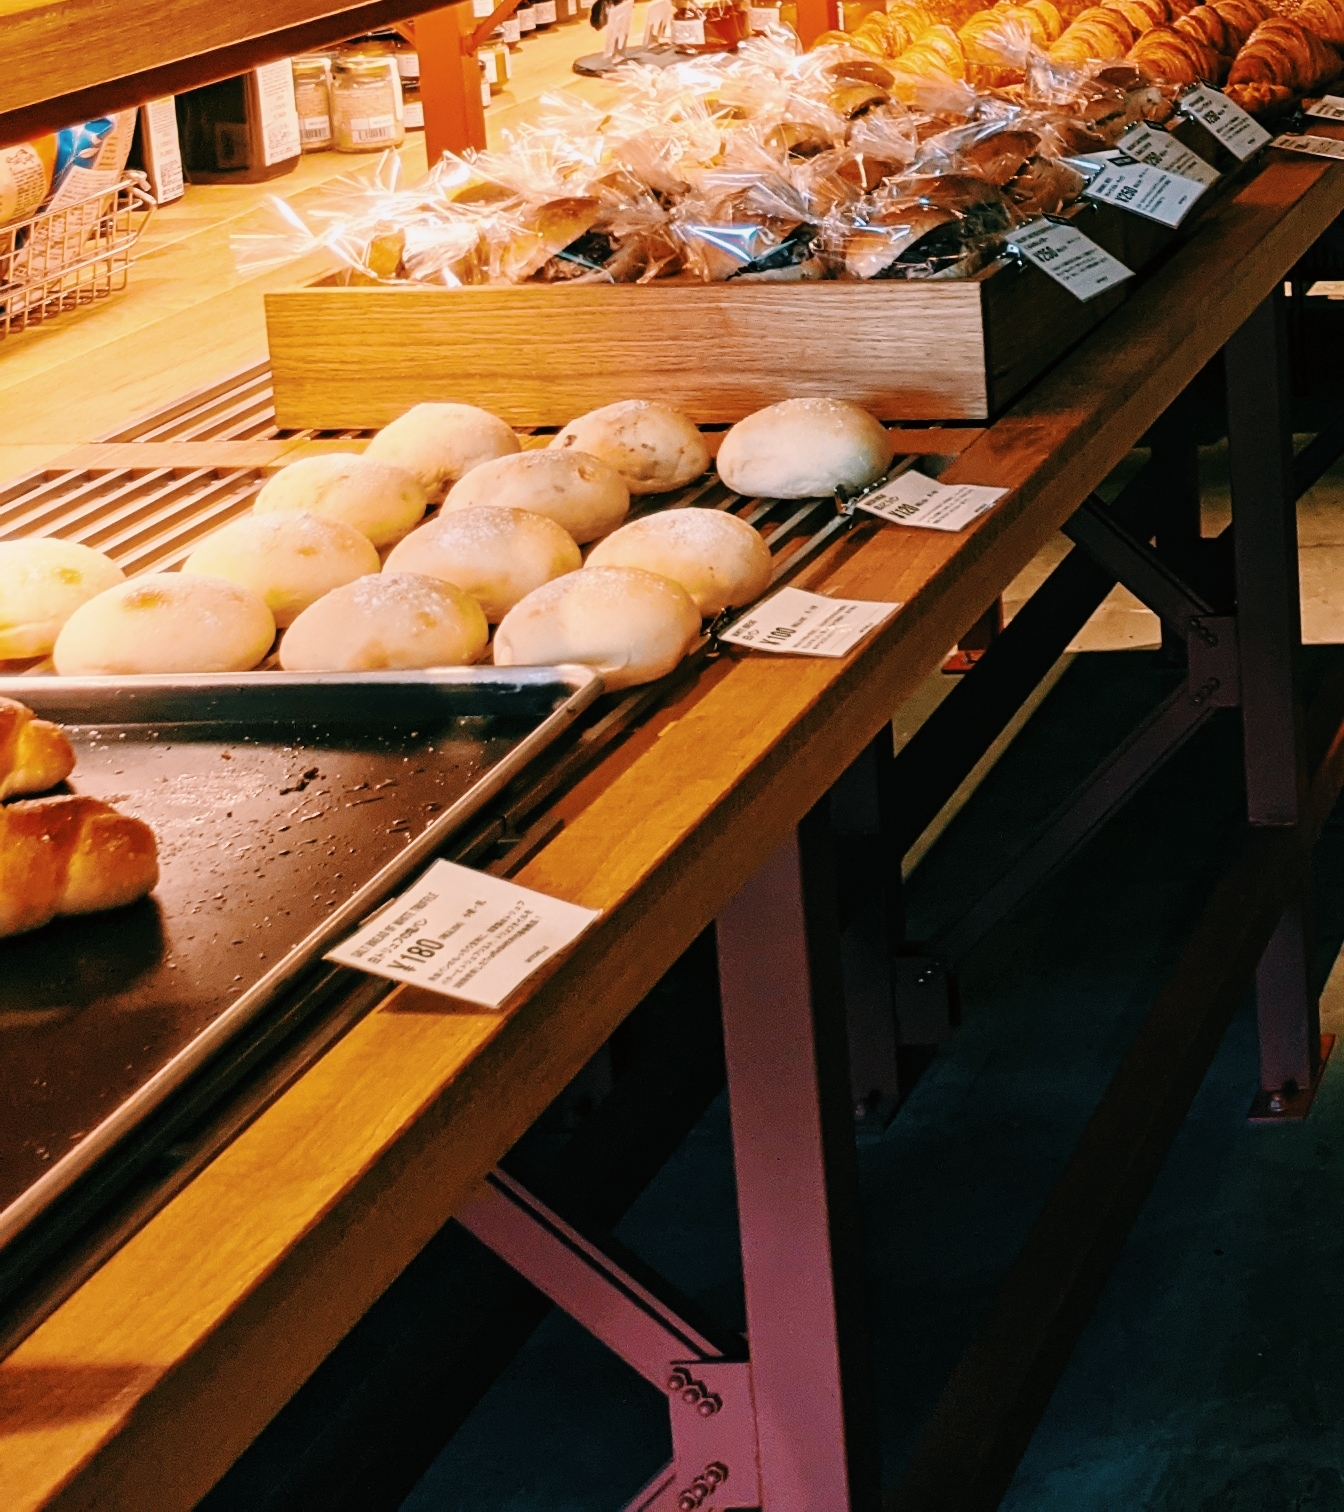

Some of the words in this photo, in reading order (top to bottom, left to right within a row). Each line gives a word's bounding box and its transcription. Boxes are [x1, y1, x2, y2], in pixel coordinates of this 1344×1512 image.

[1115, 184, 1139, 202] ¥250
[1032, 245, 1060, 263] ¥250
[885, 502, 922, 519] ¥120
[756, 625, 799, 646] ¥100
[407, 890, 441, 912] TRUFFLE
[364, 916, 430, 965] 白トリュフの塩パン
[385, 935, 447, 974] ¥180
